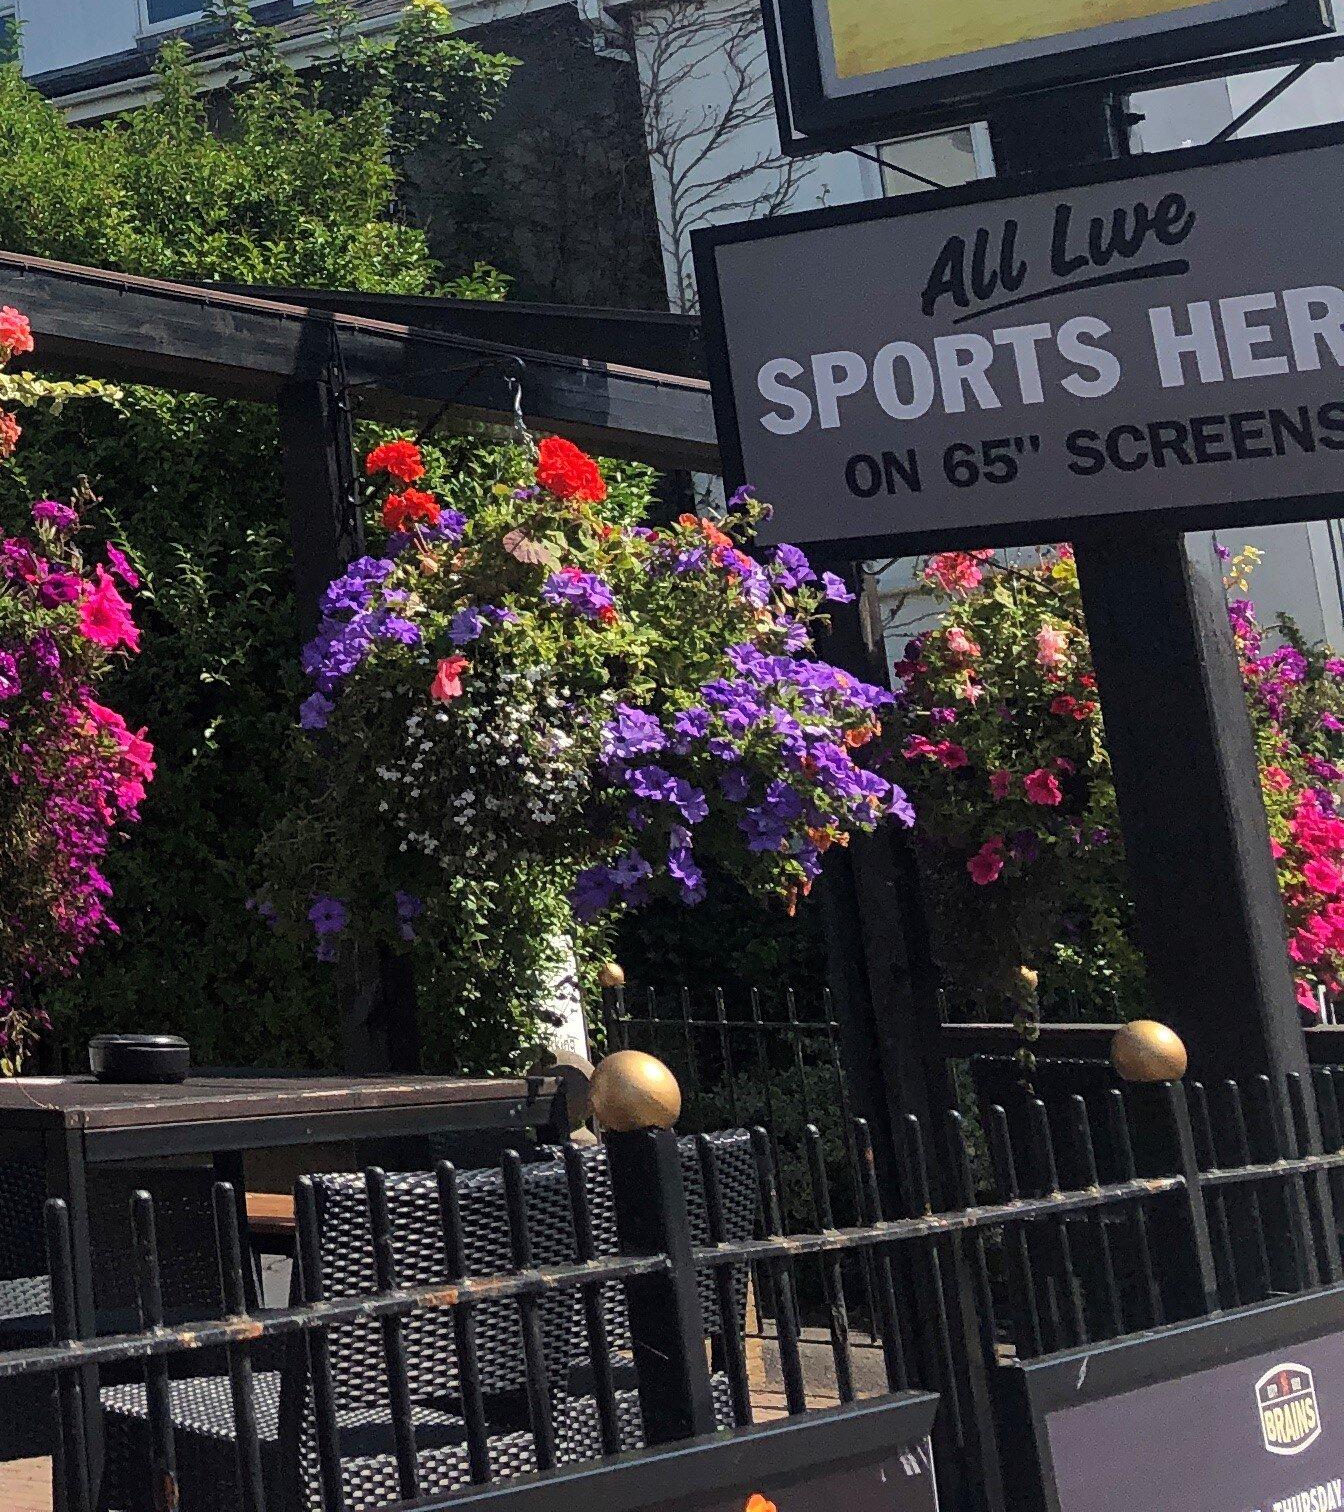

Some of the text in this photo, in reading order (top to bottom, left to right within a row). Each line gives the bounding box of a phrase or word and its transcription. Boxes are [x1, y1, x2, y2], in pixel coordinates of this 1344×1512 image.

[920, 219, 1028, 318] All
[756, 315, 1122, 436] SPORTS
[844, 400, 1344, 500] ON 65" SCREENS
[1263, 1396, 1316, 1443] BRAINS
